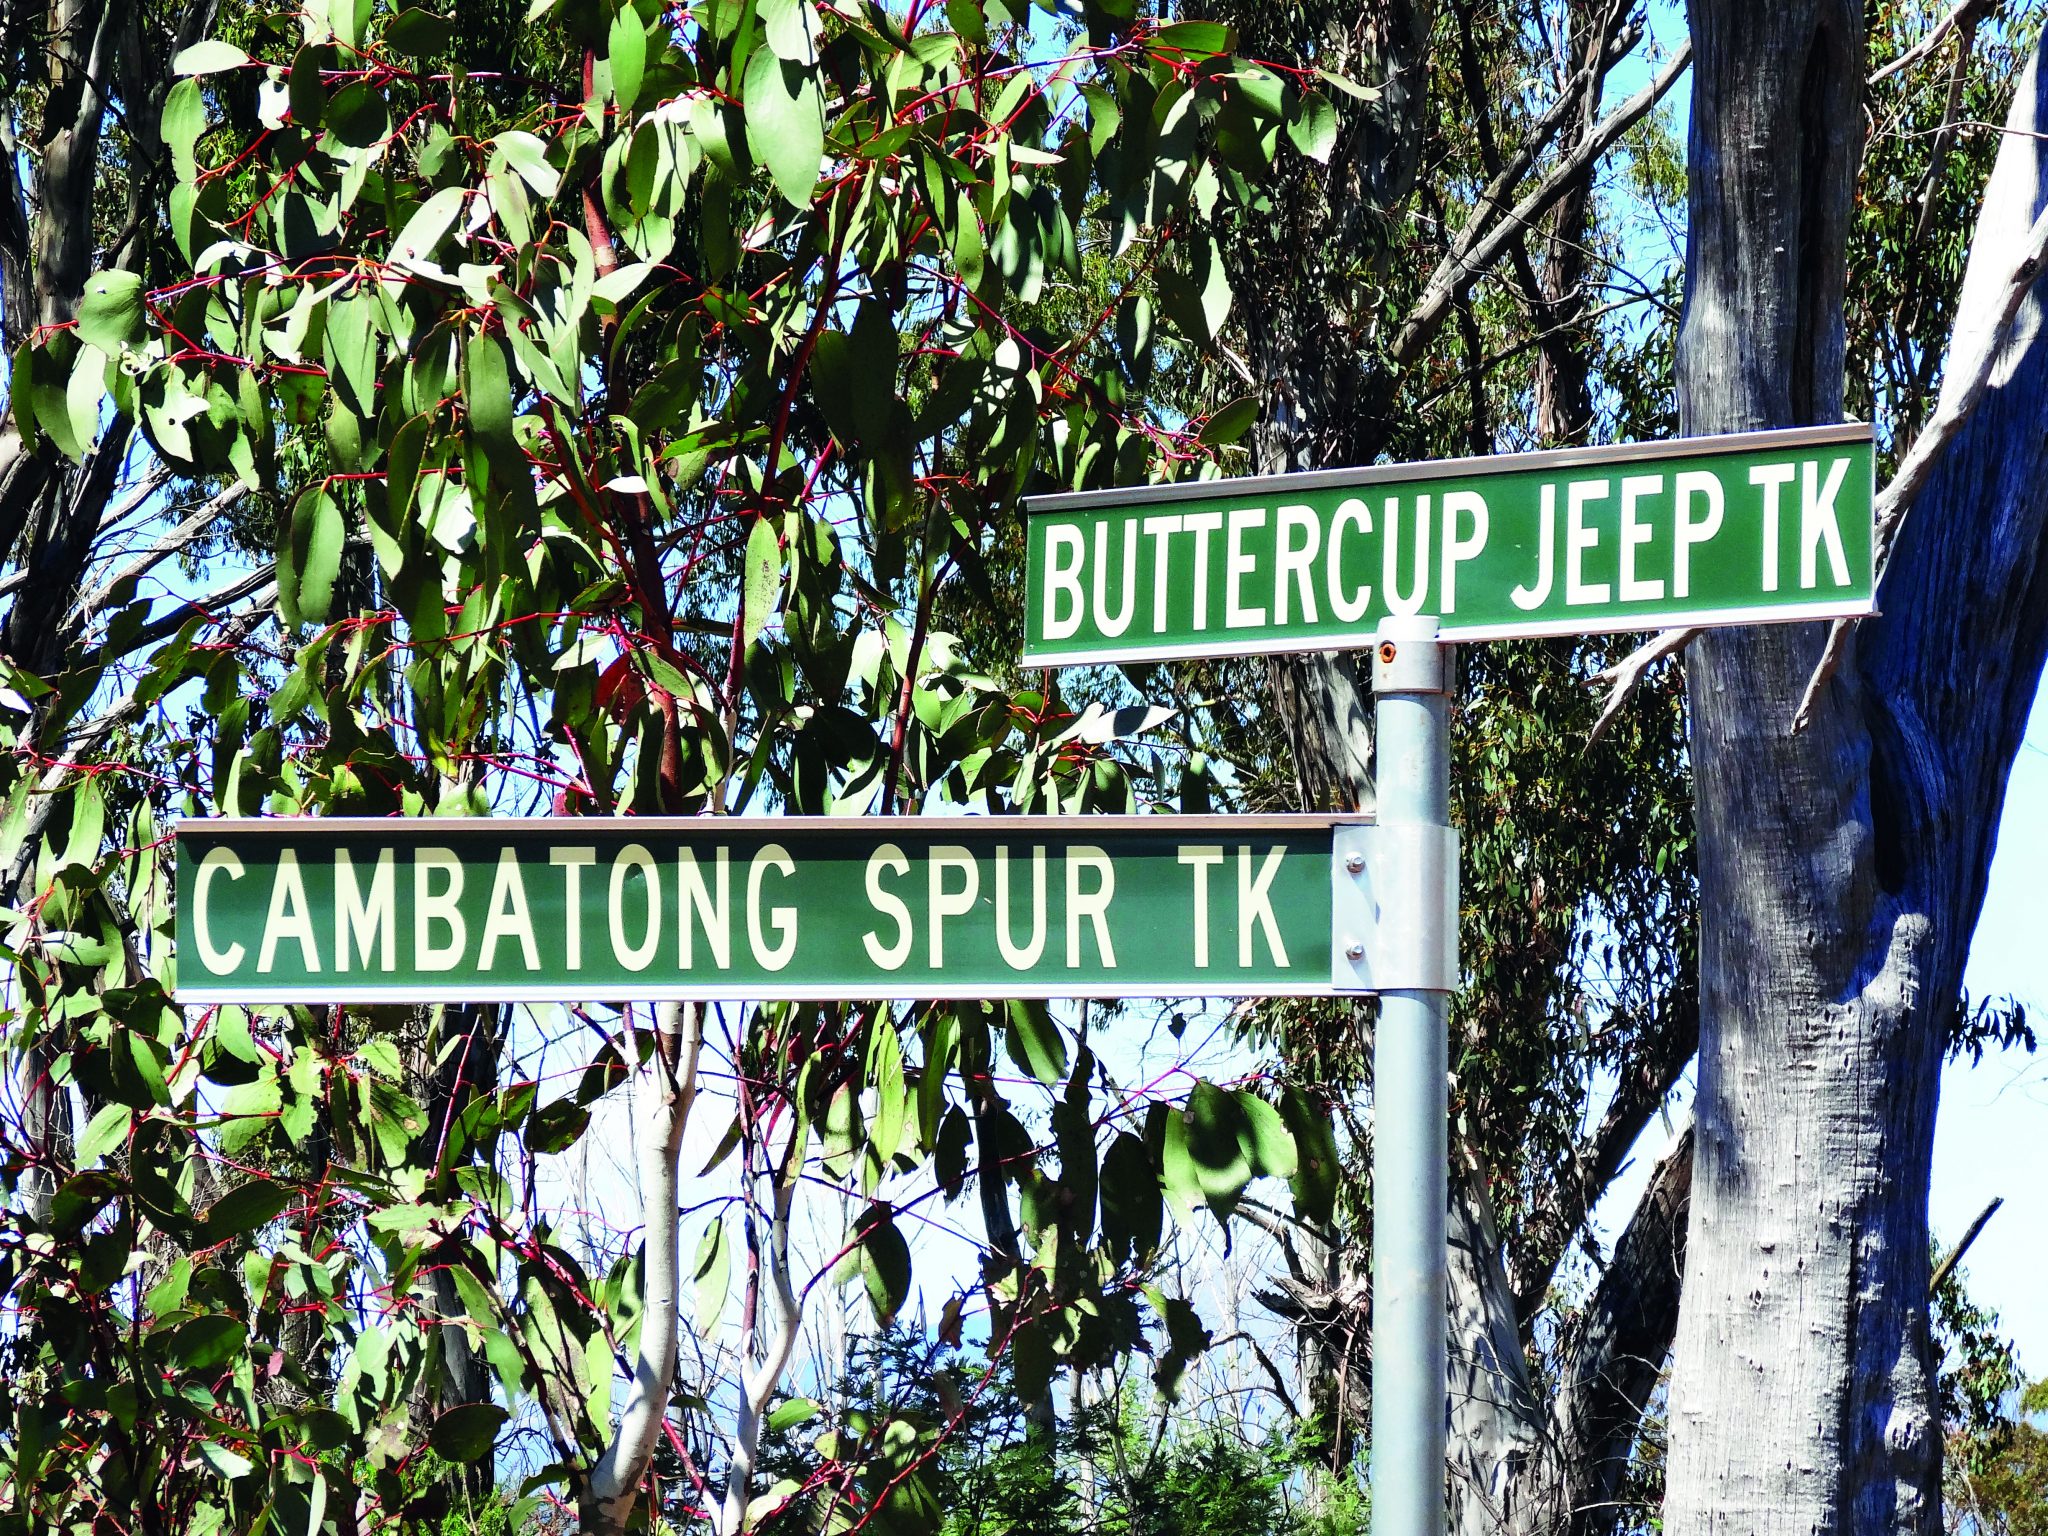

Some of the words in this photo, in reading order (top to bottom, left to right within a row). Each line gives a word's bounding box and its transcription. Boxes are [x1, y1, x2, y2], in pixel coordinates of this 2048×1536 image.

[1043, 490, 1489, 641] BUTTERCUP
[1510, 470, 1724, 612] JEEP
[1748, 457, 1852, 593] TK
[193, 843, 798, 976] CAMBATONG
[862, 843, 1117, 971] SPUR
[1177, 845, 1291, 968] TK
